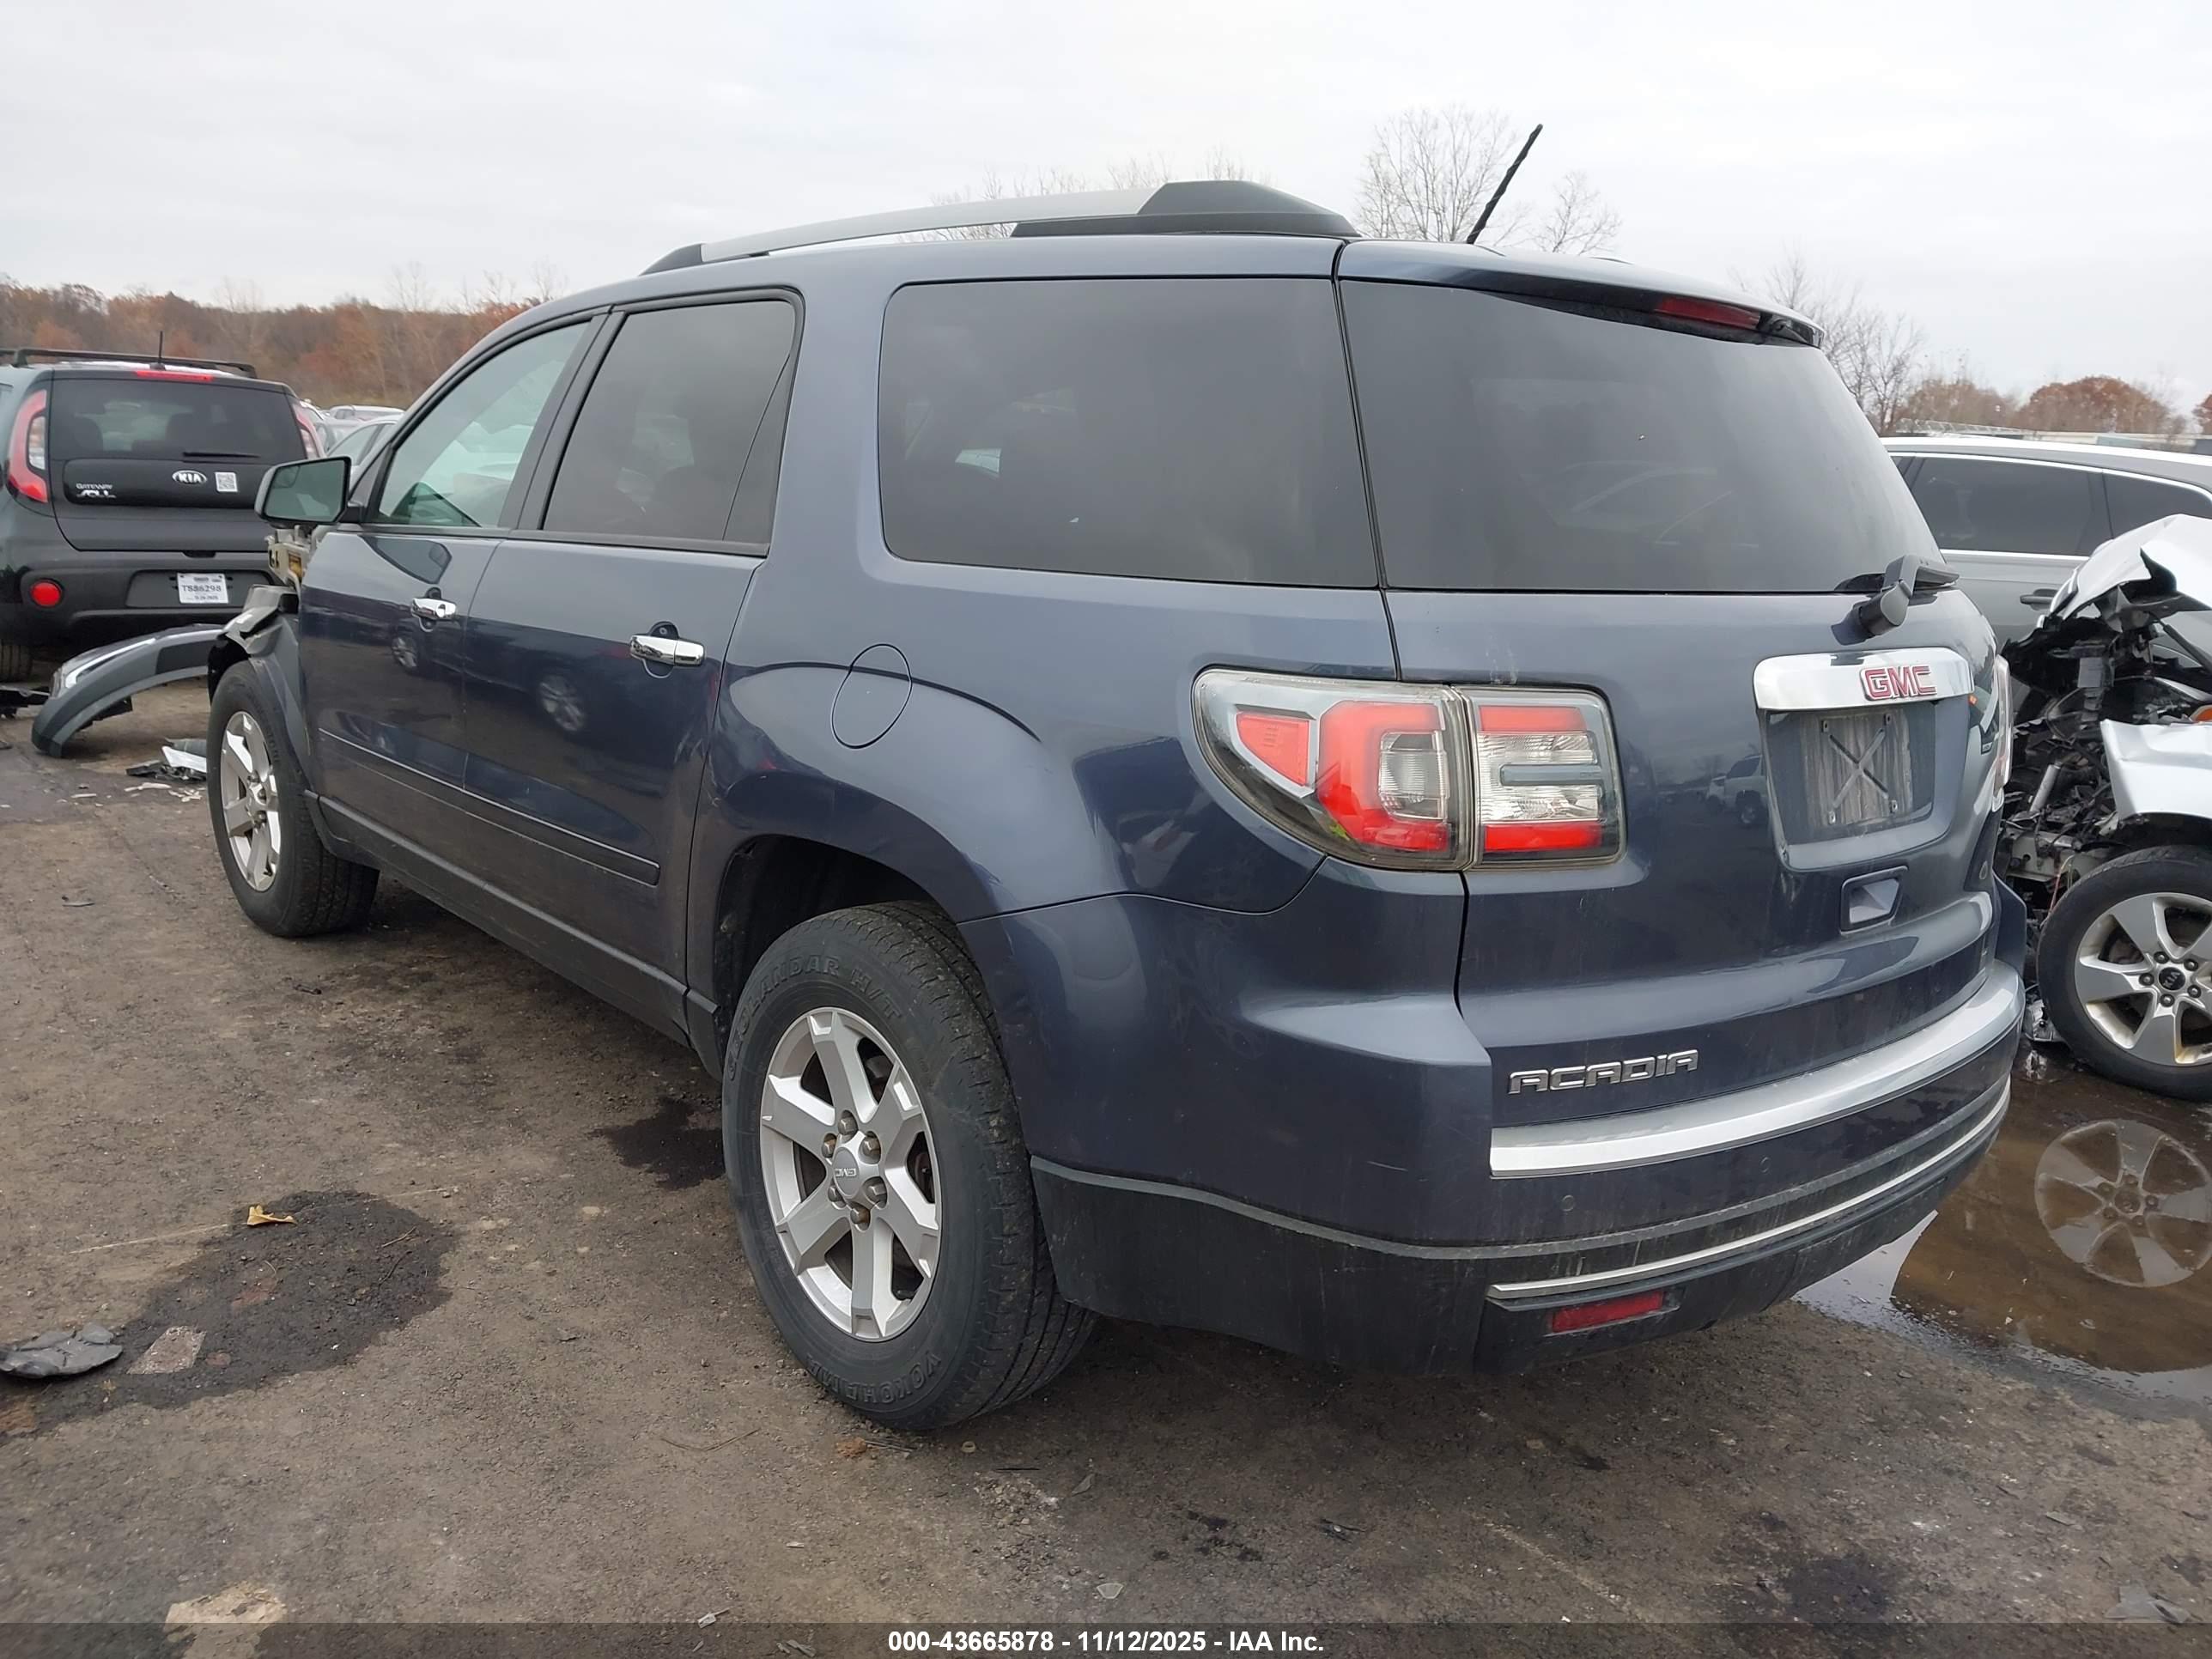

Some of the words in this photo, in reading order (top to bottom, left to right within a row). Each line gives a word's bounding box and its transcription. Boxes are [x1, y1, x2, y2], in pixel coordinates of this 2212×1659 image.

[177, 472, 203, 483] KIA
[1860, 665, 1937, 701] GMC
[2163, 971, 2180, 988] KIA
[850, 969, 902, 1019] H/T
[1508, 1049, 1698, 1095] ACADIA
[835, 1168, 857, 1176] GMC
